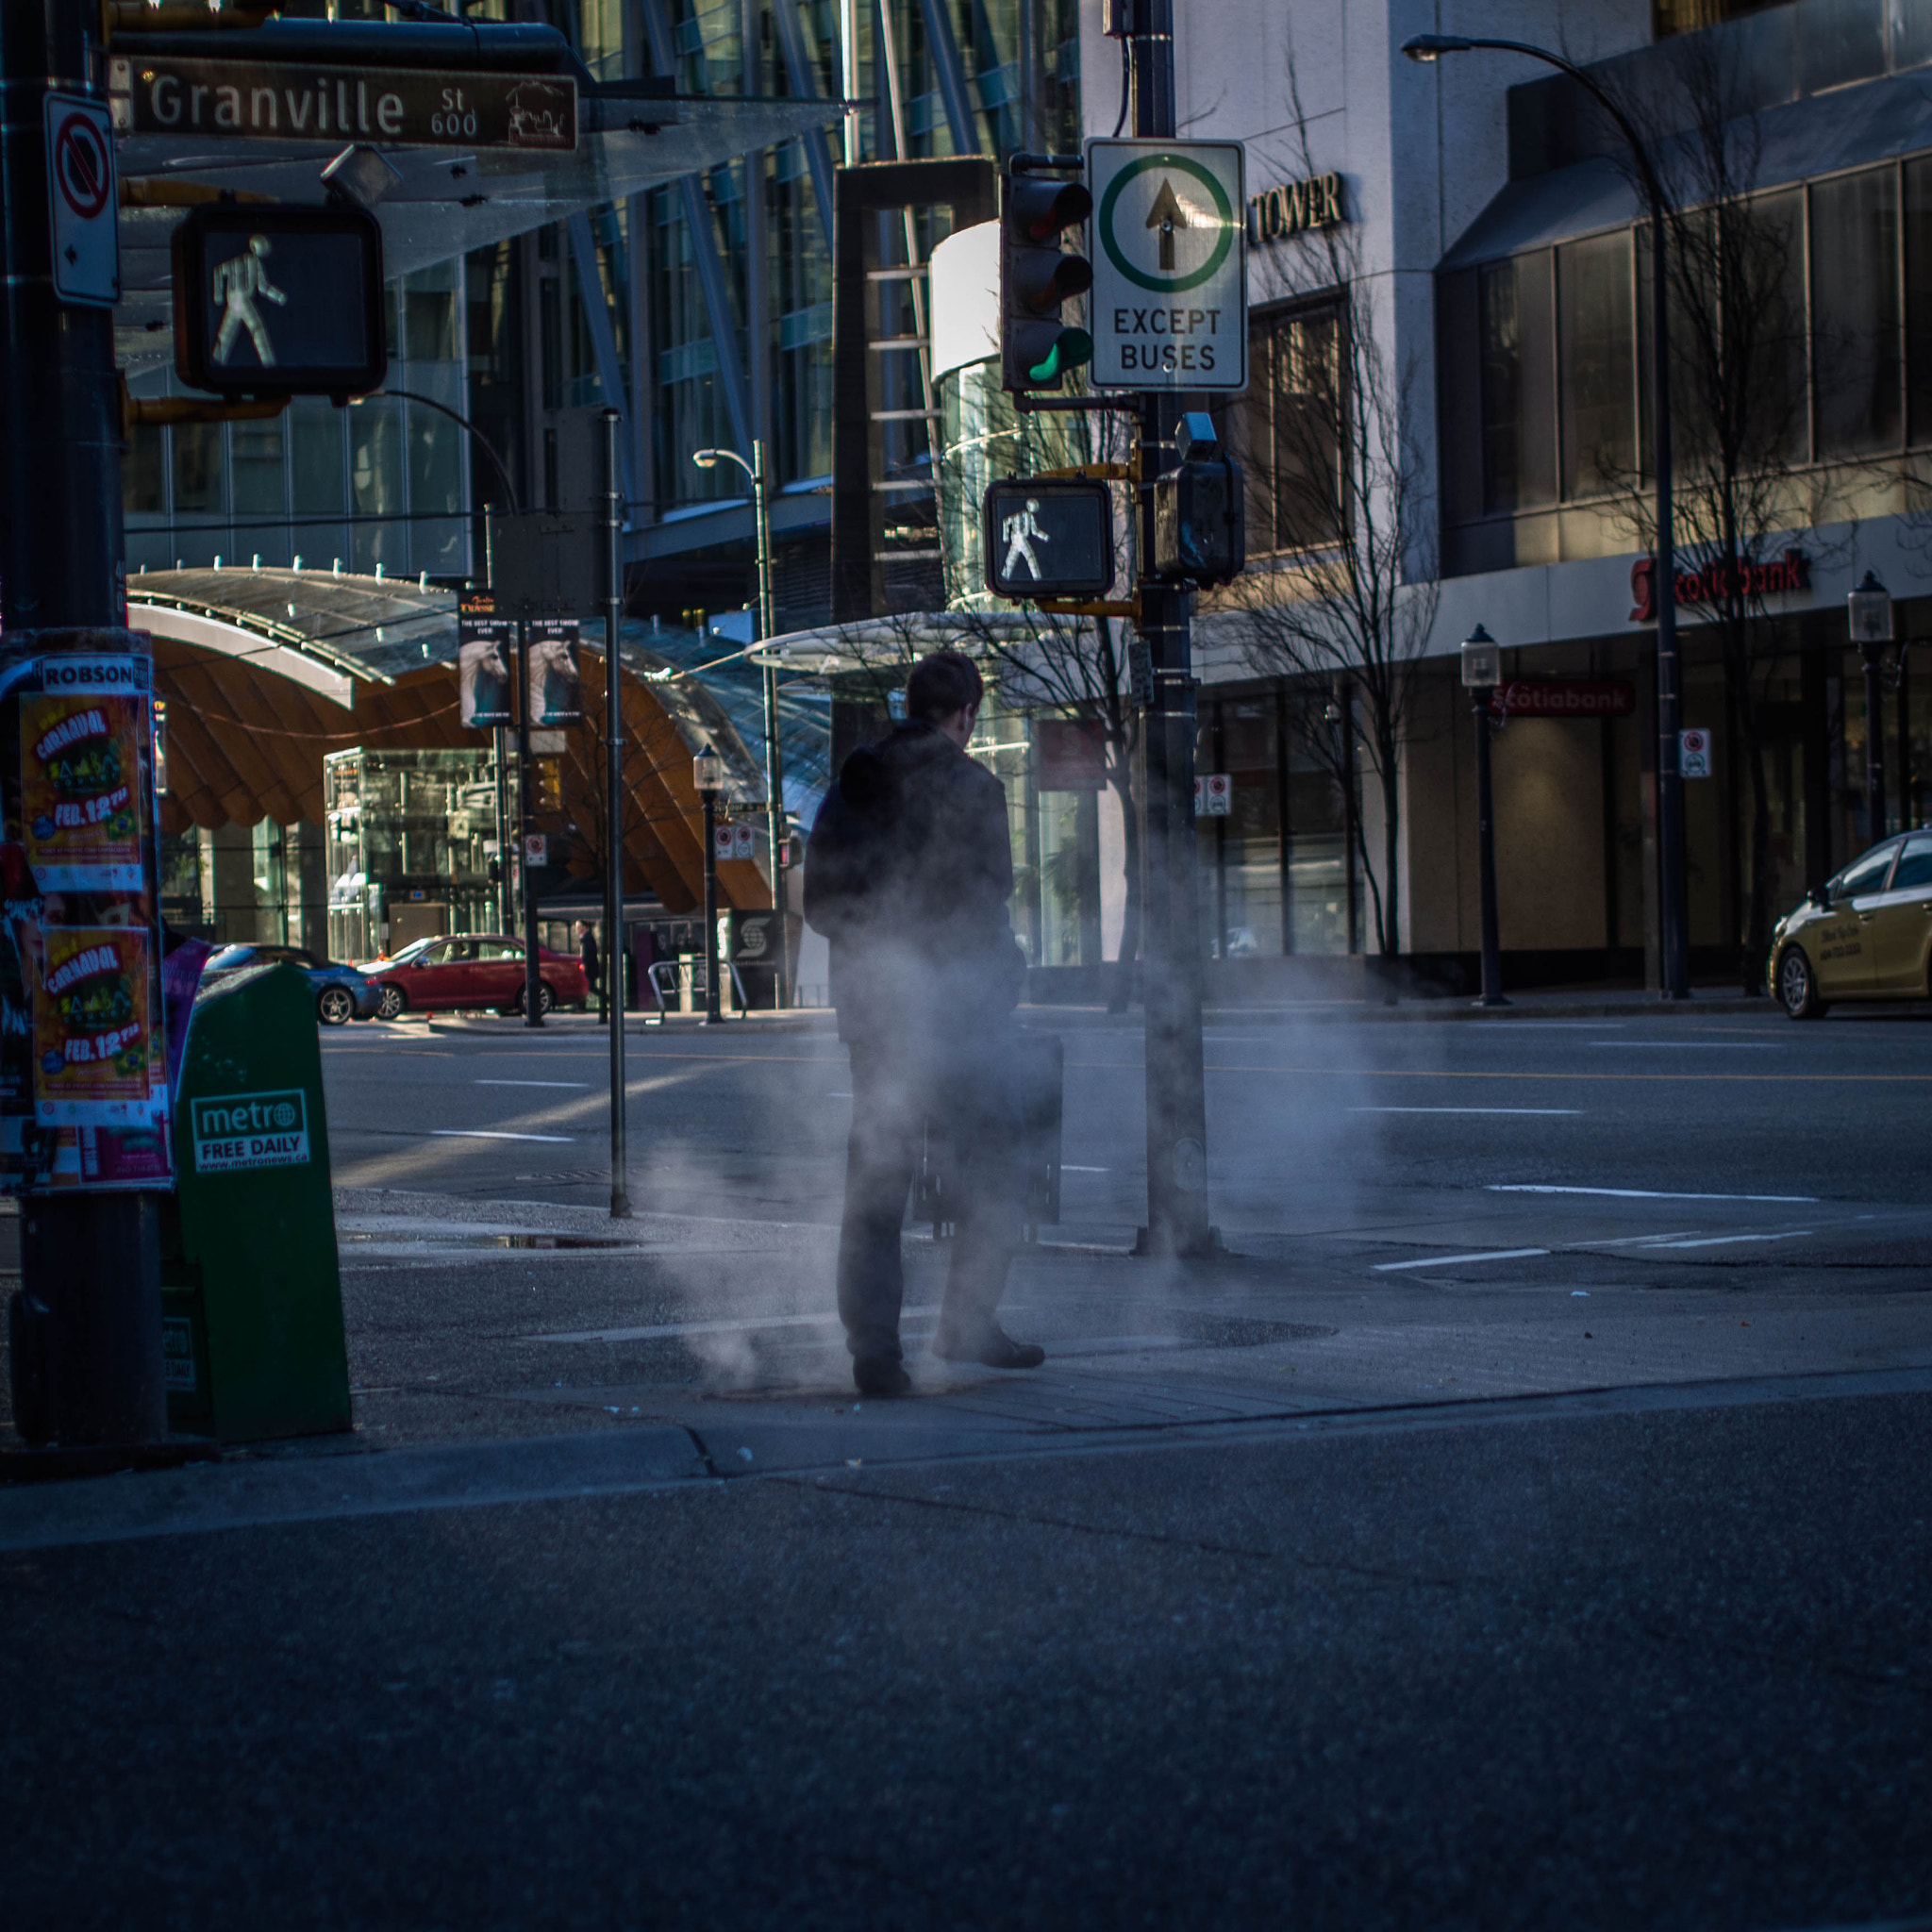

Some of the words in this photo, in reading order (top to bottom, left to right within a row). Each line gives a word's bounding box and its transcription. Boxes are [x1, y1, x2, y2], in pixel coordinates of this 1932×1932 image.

[150, 74, 405, 135] Granville
[441, 87, 465, 112] St
[430, 111, 477, 137] 600
[1250, 172, 1342, 242] TOWER
[1114, 308, 1221, 335] EXCEPT
[1121, 344, 1215, 371] BUSES
[46, 667, 132, 685] ROBSON
[1491, 687, 1626, 709] Scotiabank
[36, 709, 106, 759] CARNAVAL
[55, 803, 86, 826] FEB.
[48, 945, 119, 993] CARNAVAL
[65, 1039, 96, 1061] FEB.
[202, 1101, 295, 1132] metro
[202, 1141, 244, 1159] FREE
[250, 1136, 300, 1156] DAILY
[199, 1153, 308, 1171] www.metronews.ca
